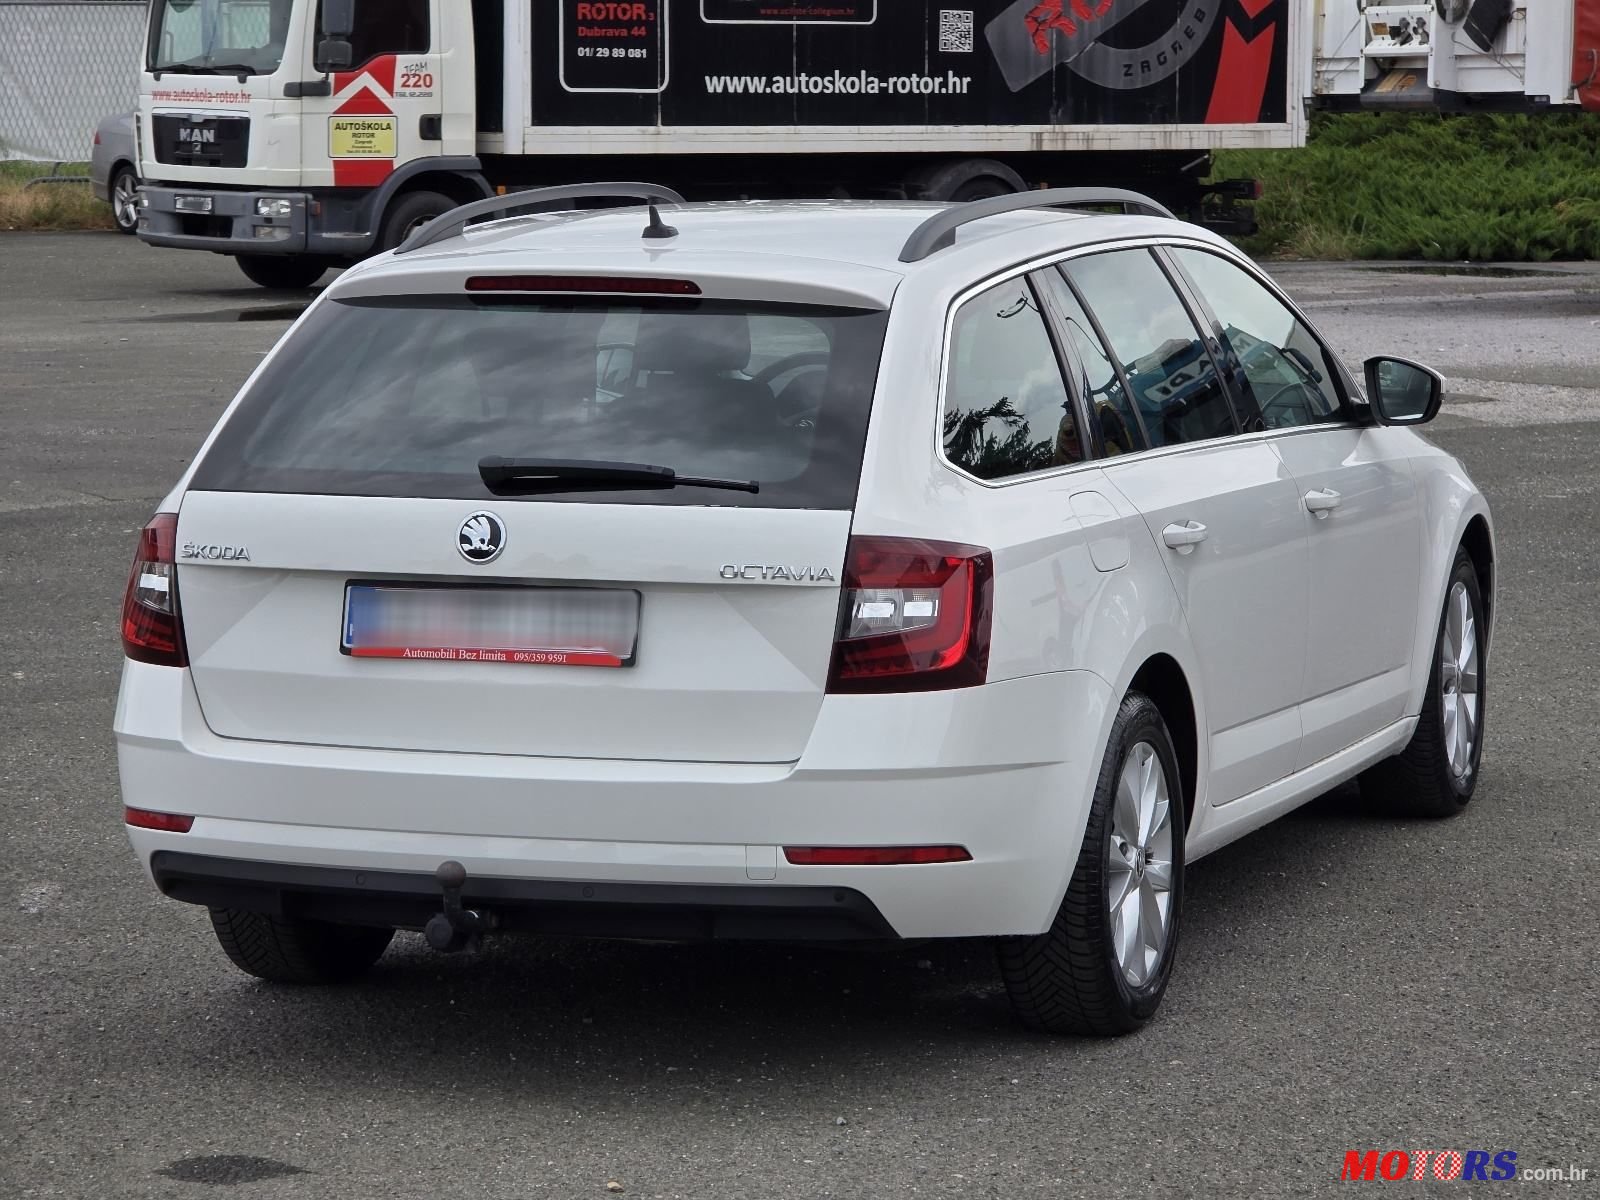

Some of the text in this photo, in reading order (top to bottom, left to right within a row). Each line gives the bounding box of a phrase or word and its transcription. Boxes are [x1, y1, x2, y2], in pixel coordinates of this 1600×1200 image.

[577, 2, 646, 20] ROTOR
[578, 26, 647, 37] Dubrava 44
[1123, 7, 1207, 77] ZAGREB
[596, 47, 610, 57] 29
[611, 47, 626, 58] 89
[627, 48, 647, 59] 081
[400, 73, 433, 88] 220
[705, 70, 971, 94] www.autoskola-rotor.hr
[152, 88, 251, 104] www.autoskola-rotor.hr
[334, 120, 392, 131] AUTOŠKOLA
[179, 128, 215, 143] MAN
[181, 541, 251, 561] ŠKODA
[720, 563, 836, 582] OCTAVIA
[403, 647, 567, 664] Automobili Bez limita 095/359 9591
